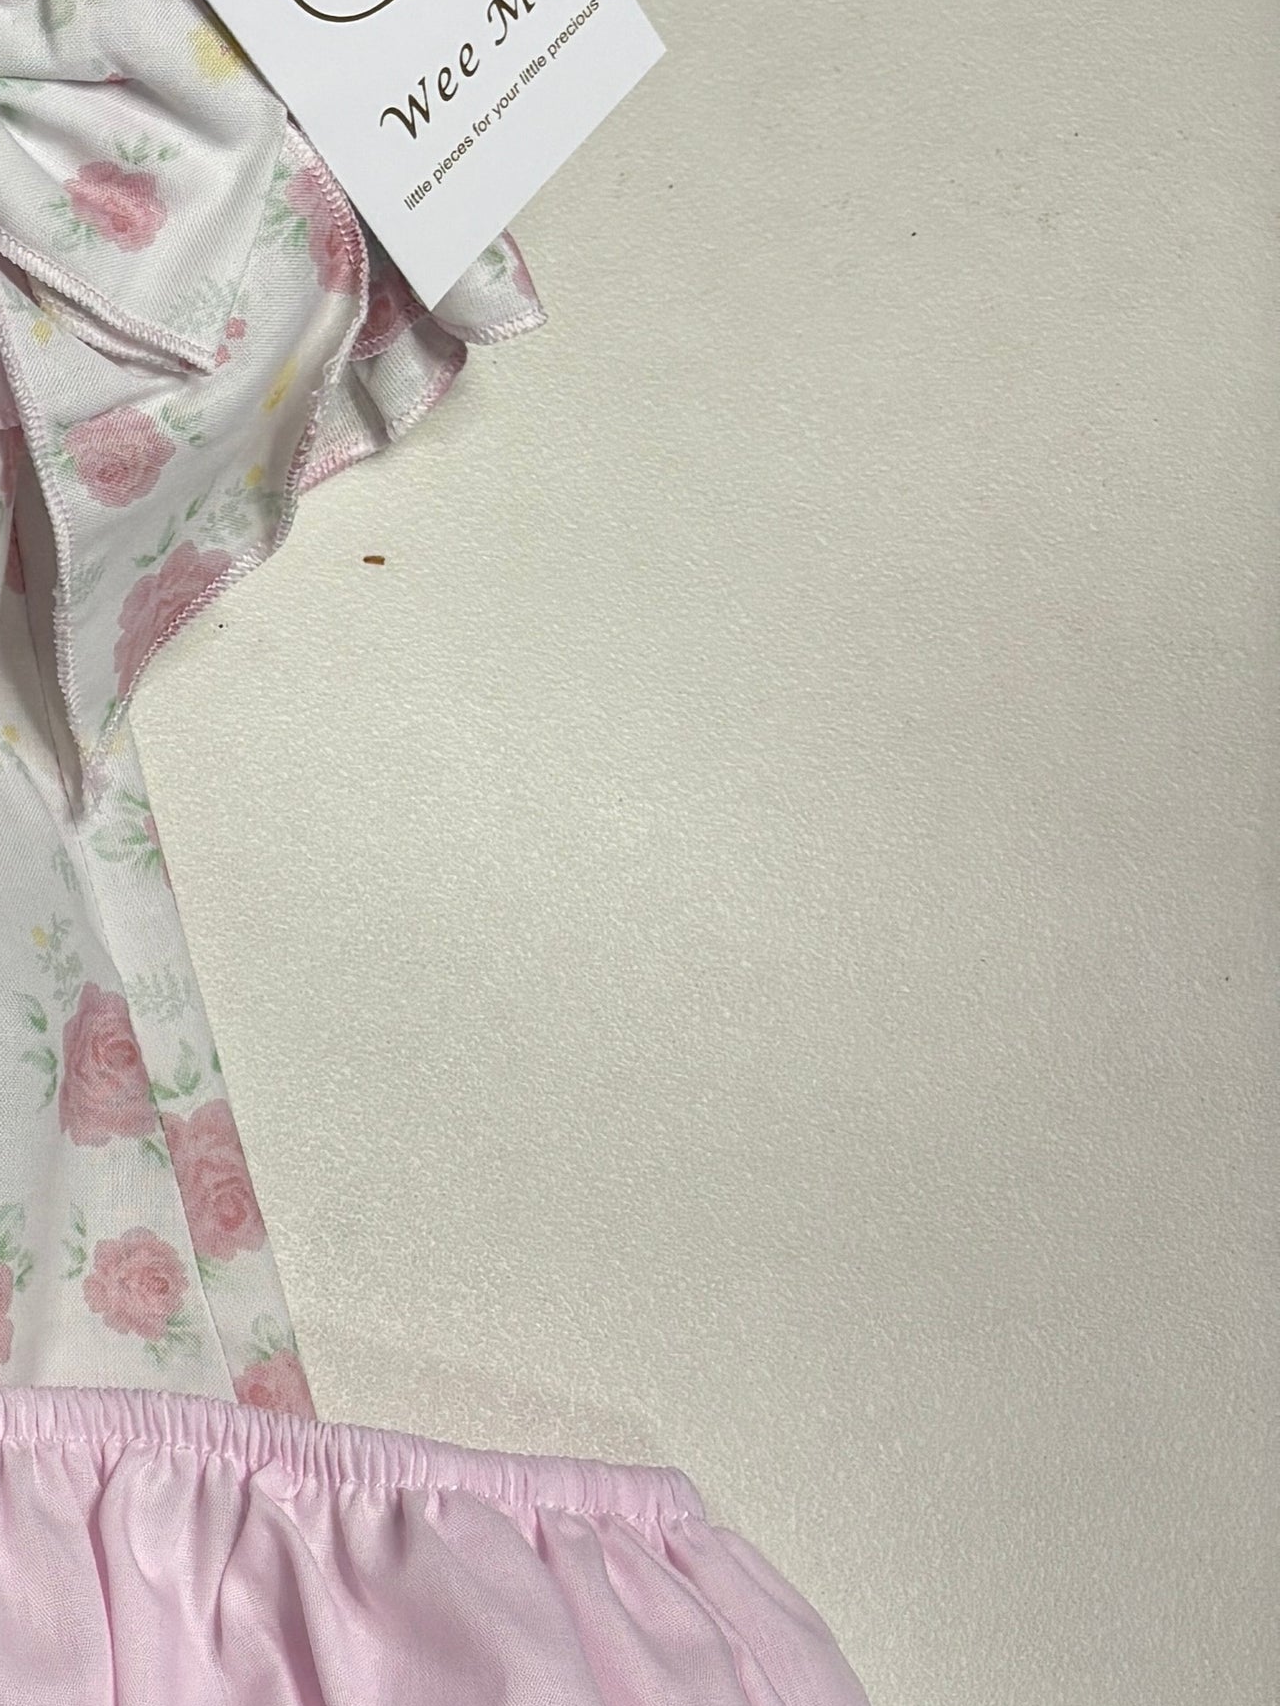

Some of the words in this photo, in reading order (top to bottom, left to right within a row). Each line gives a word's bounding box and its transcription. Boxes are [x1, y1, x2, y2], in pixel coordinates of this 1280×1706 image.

[379, 42, 481, 140] Wee
[403, 180, 433, 211] little
[432, 135, 474, 184] pieces
[472, 113, 493, 137] for
[491, 82, 520, 120] your
[518, 55, 548, 86] little
